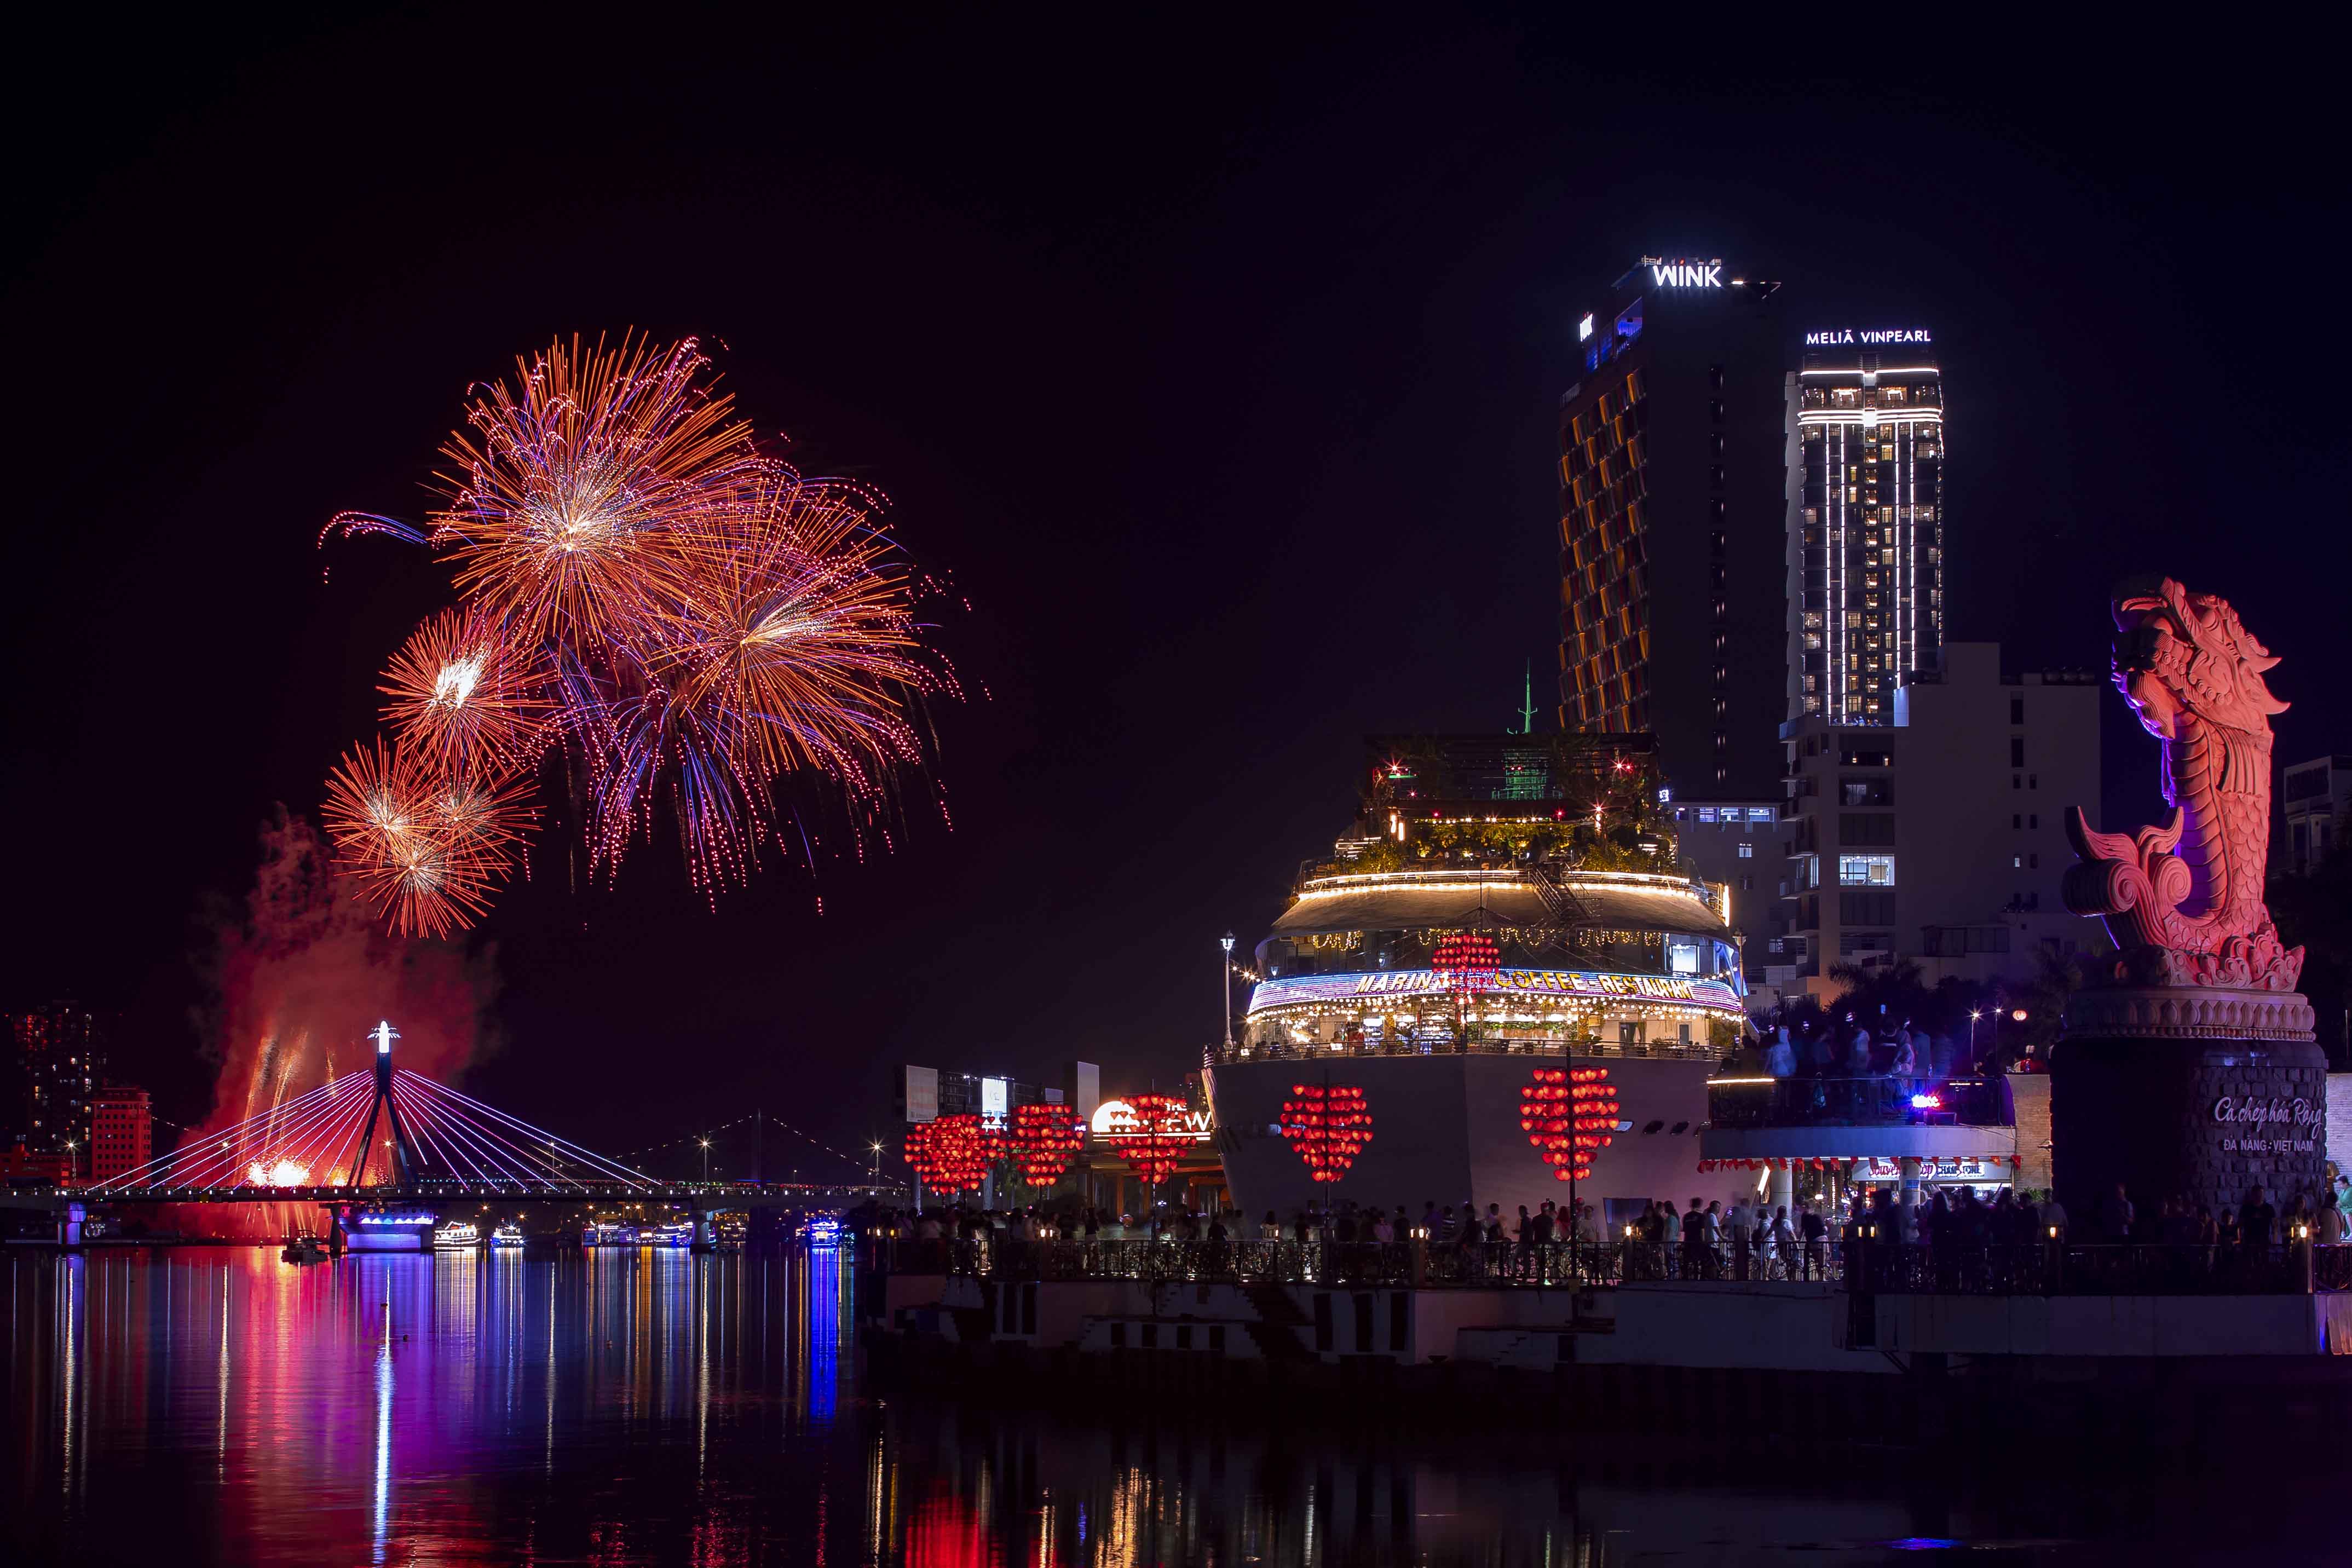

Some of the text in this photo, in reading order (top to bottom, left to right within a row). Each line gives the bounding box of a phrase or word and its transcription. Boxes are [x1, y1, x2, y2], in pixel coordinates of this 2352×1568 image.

[1652, 265, 1722, 287] WINK
[1860, 330, 1932, 343] VINPEARL
[1495, 972, 1587, 990] COFFEE
[2215, 1097, 2238, 1121] Cá
[2238, 1097, 2268, 1132] chép
[2294, 1140, 2313, 1151] NAM
